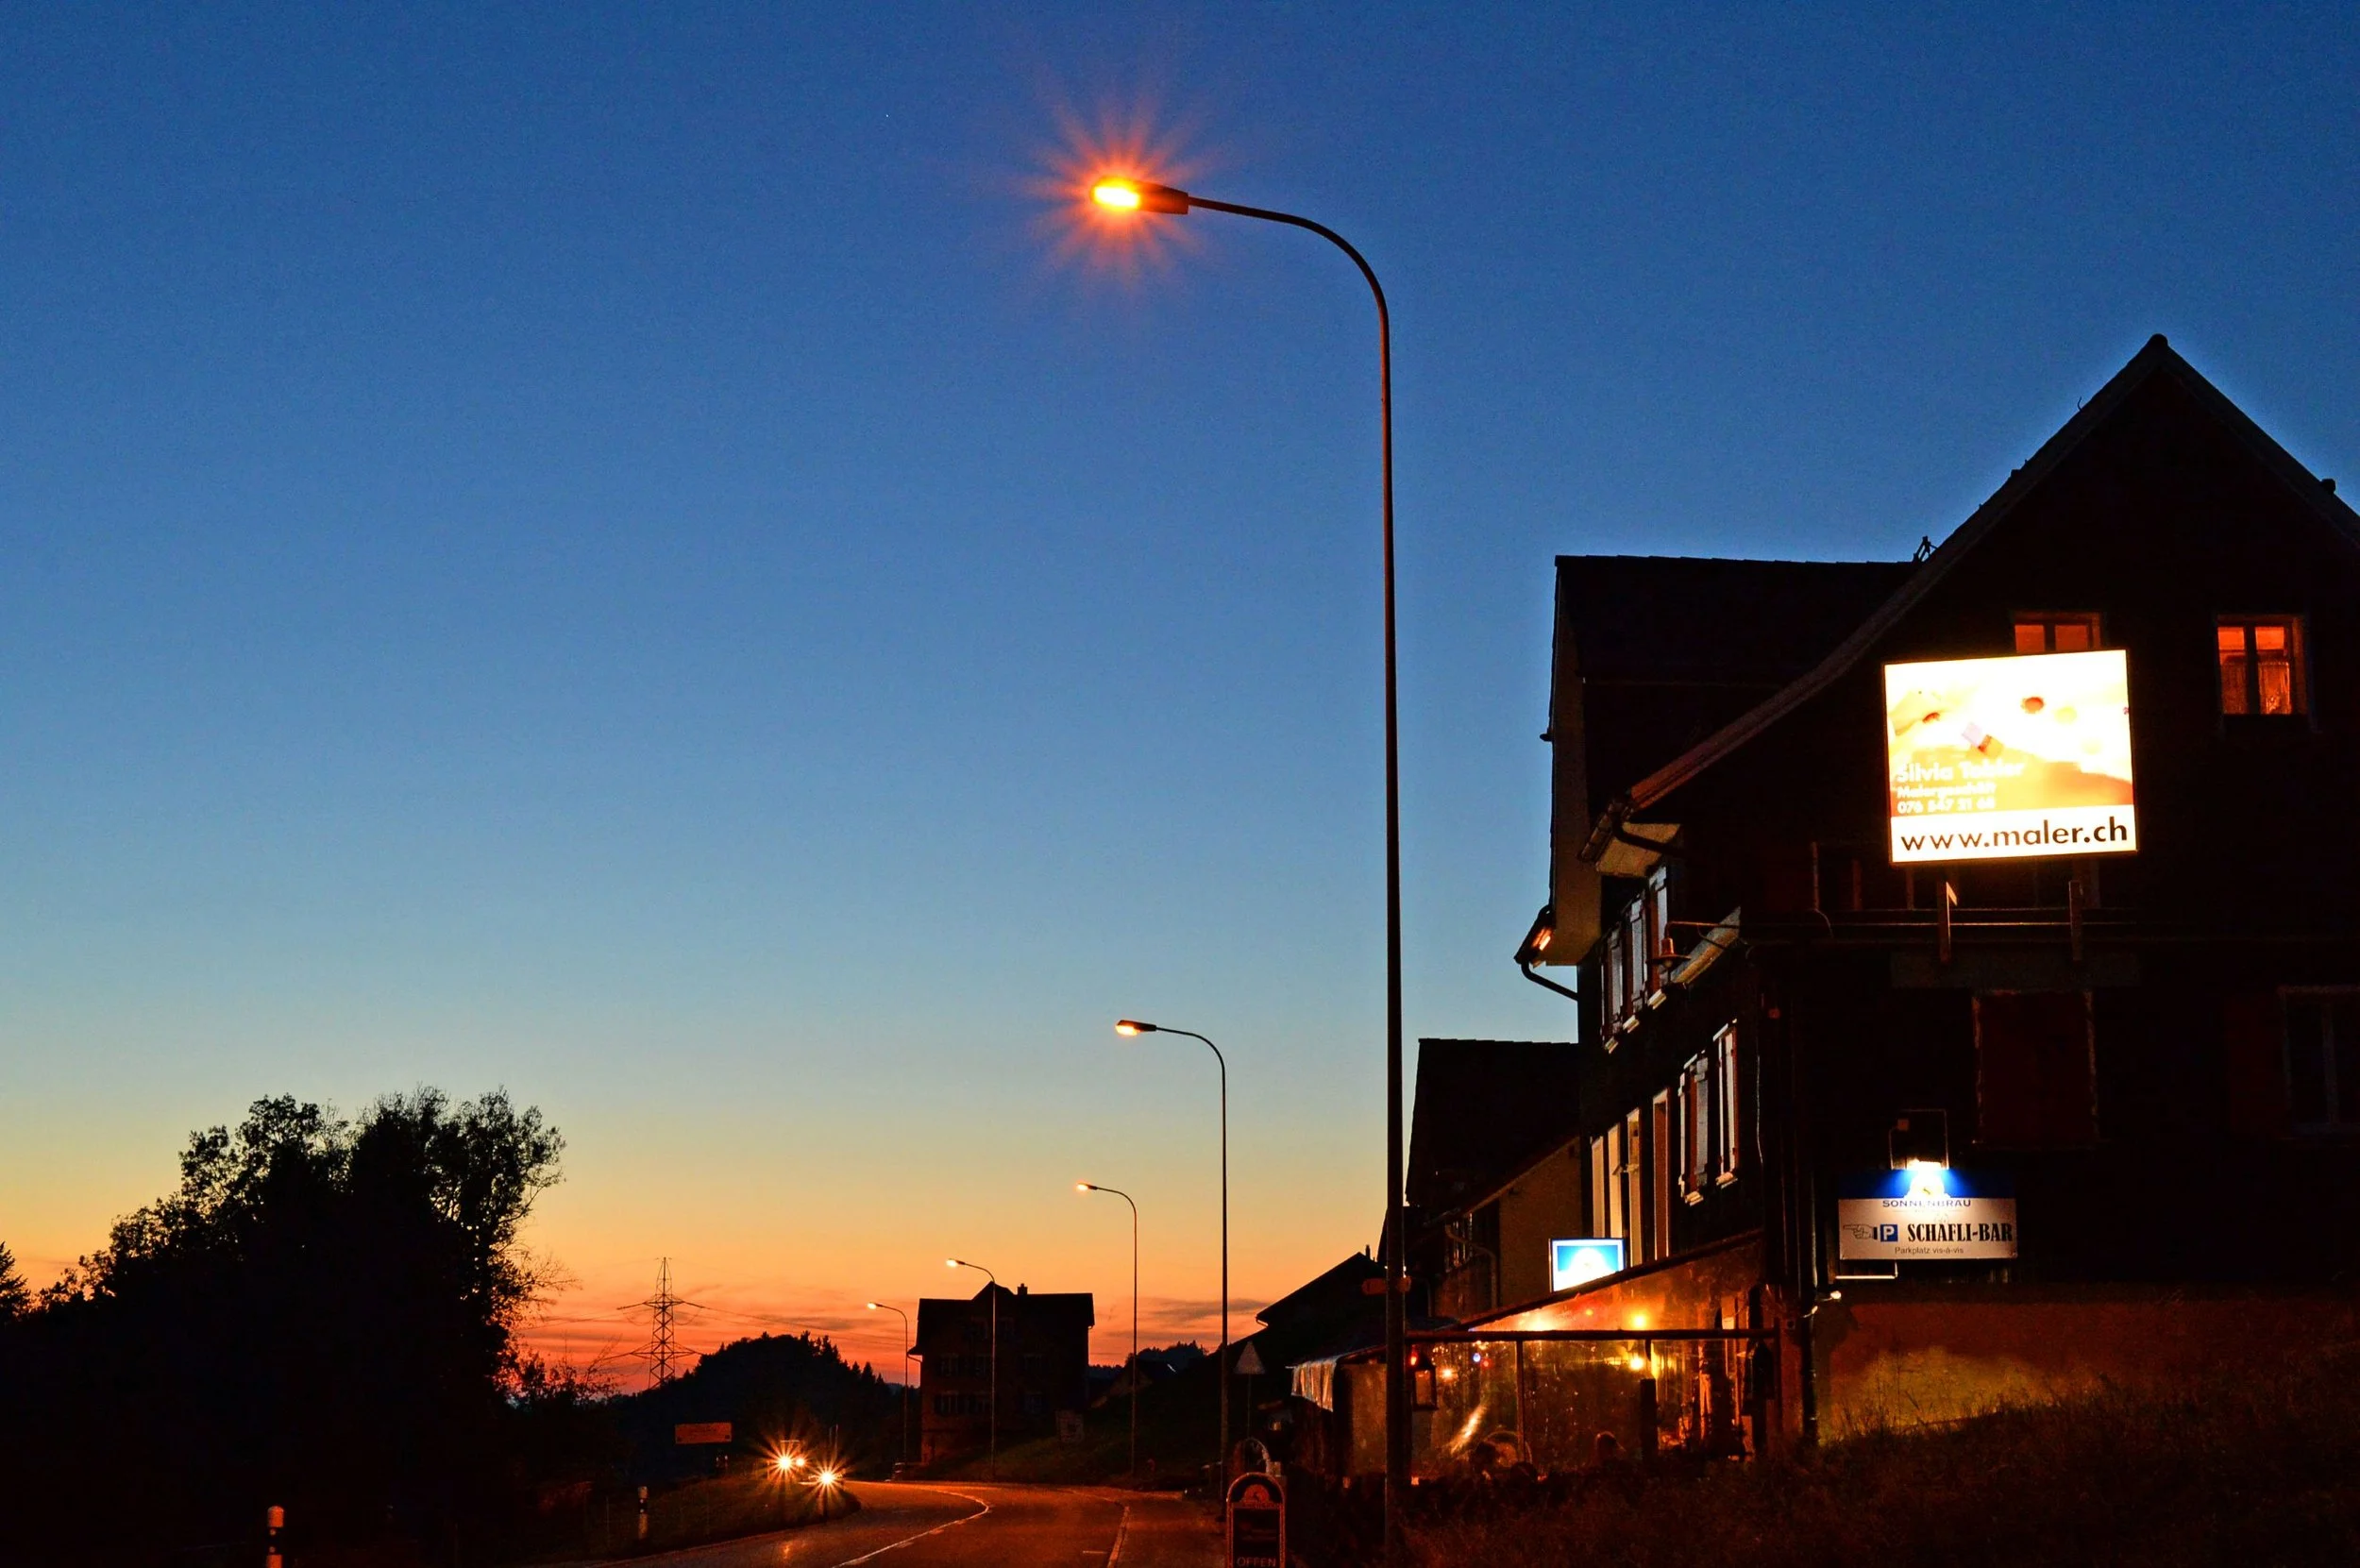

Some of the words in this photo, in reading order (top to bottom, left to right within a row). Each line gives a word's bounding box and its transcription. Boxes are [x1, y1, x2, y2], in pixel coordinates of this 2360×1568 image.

[1897, 763, 1953, 783] Silvia
[1901, 816, 2128, 851] www.maler.ch
[1883, 1225, 1895, 1240] P
[1895, 1246, 1930, 1256] Parkplatz
